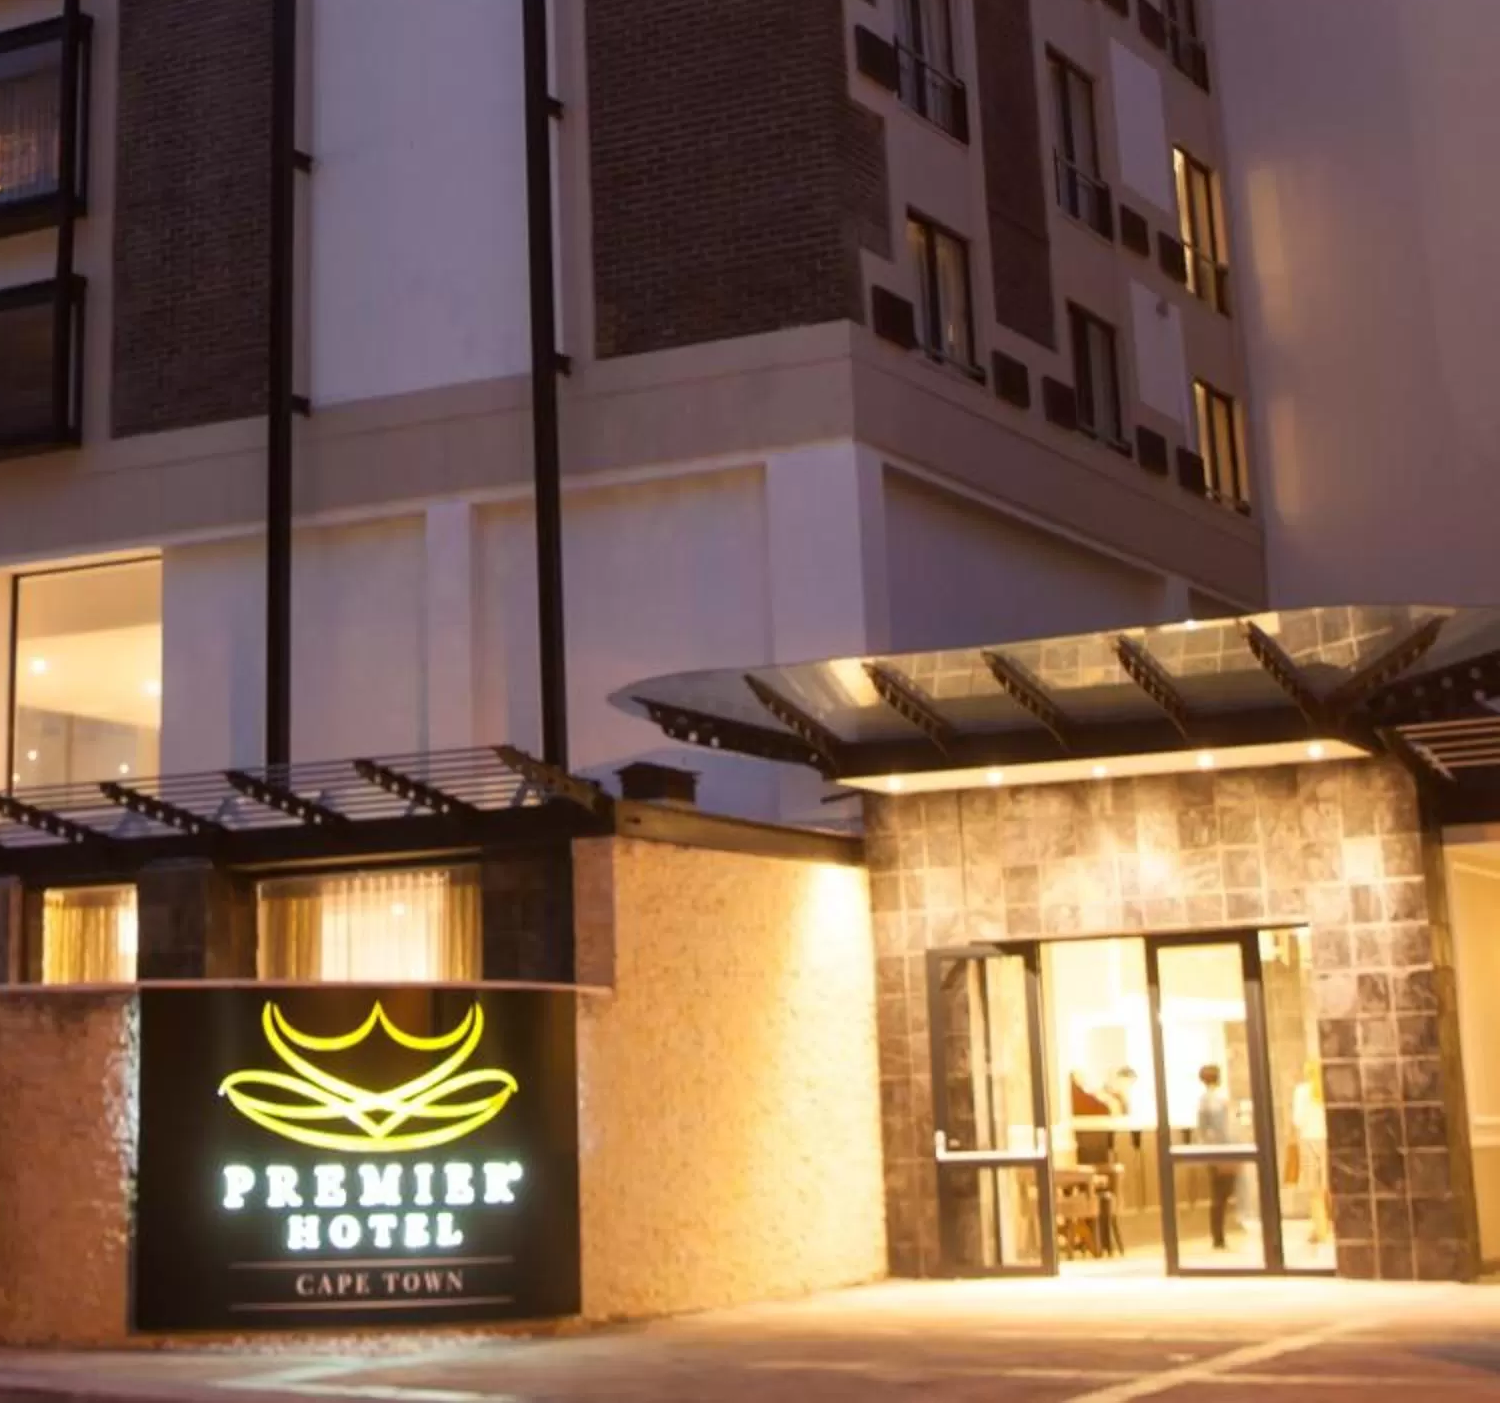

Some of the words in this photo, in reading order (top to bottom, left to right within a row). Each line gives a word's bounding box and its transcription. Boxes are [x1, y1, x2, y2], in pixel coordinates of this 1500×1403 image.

[222, 1160, 523, 1209] PREMIER
[286, 1212, 465, 1250] HOTEL
[296, 1272, 371, 1297] CAPE
[381, 1269, 465, 1293] TOWN
